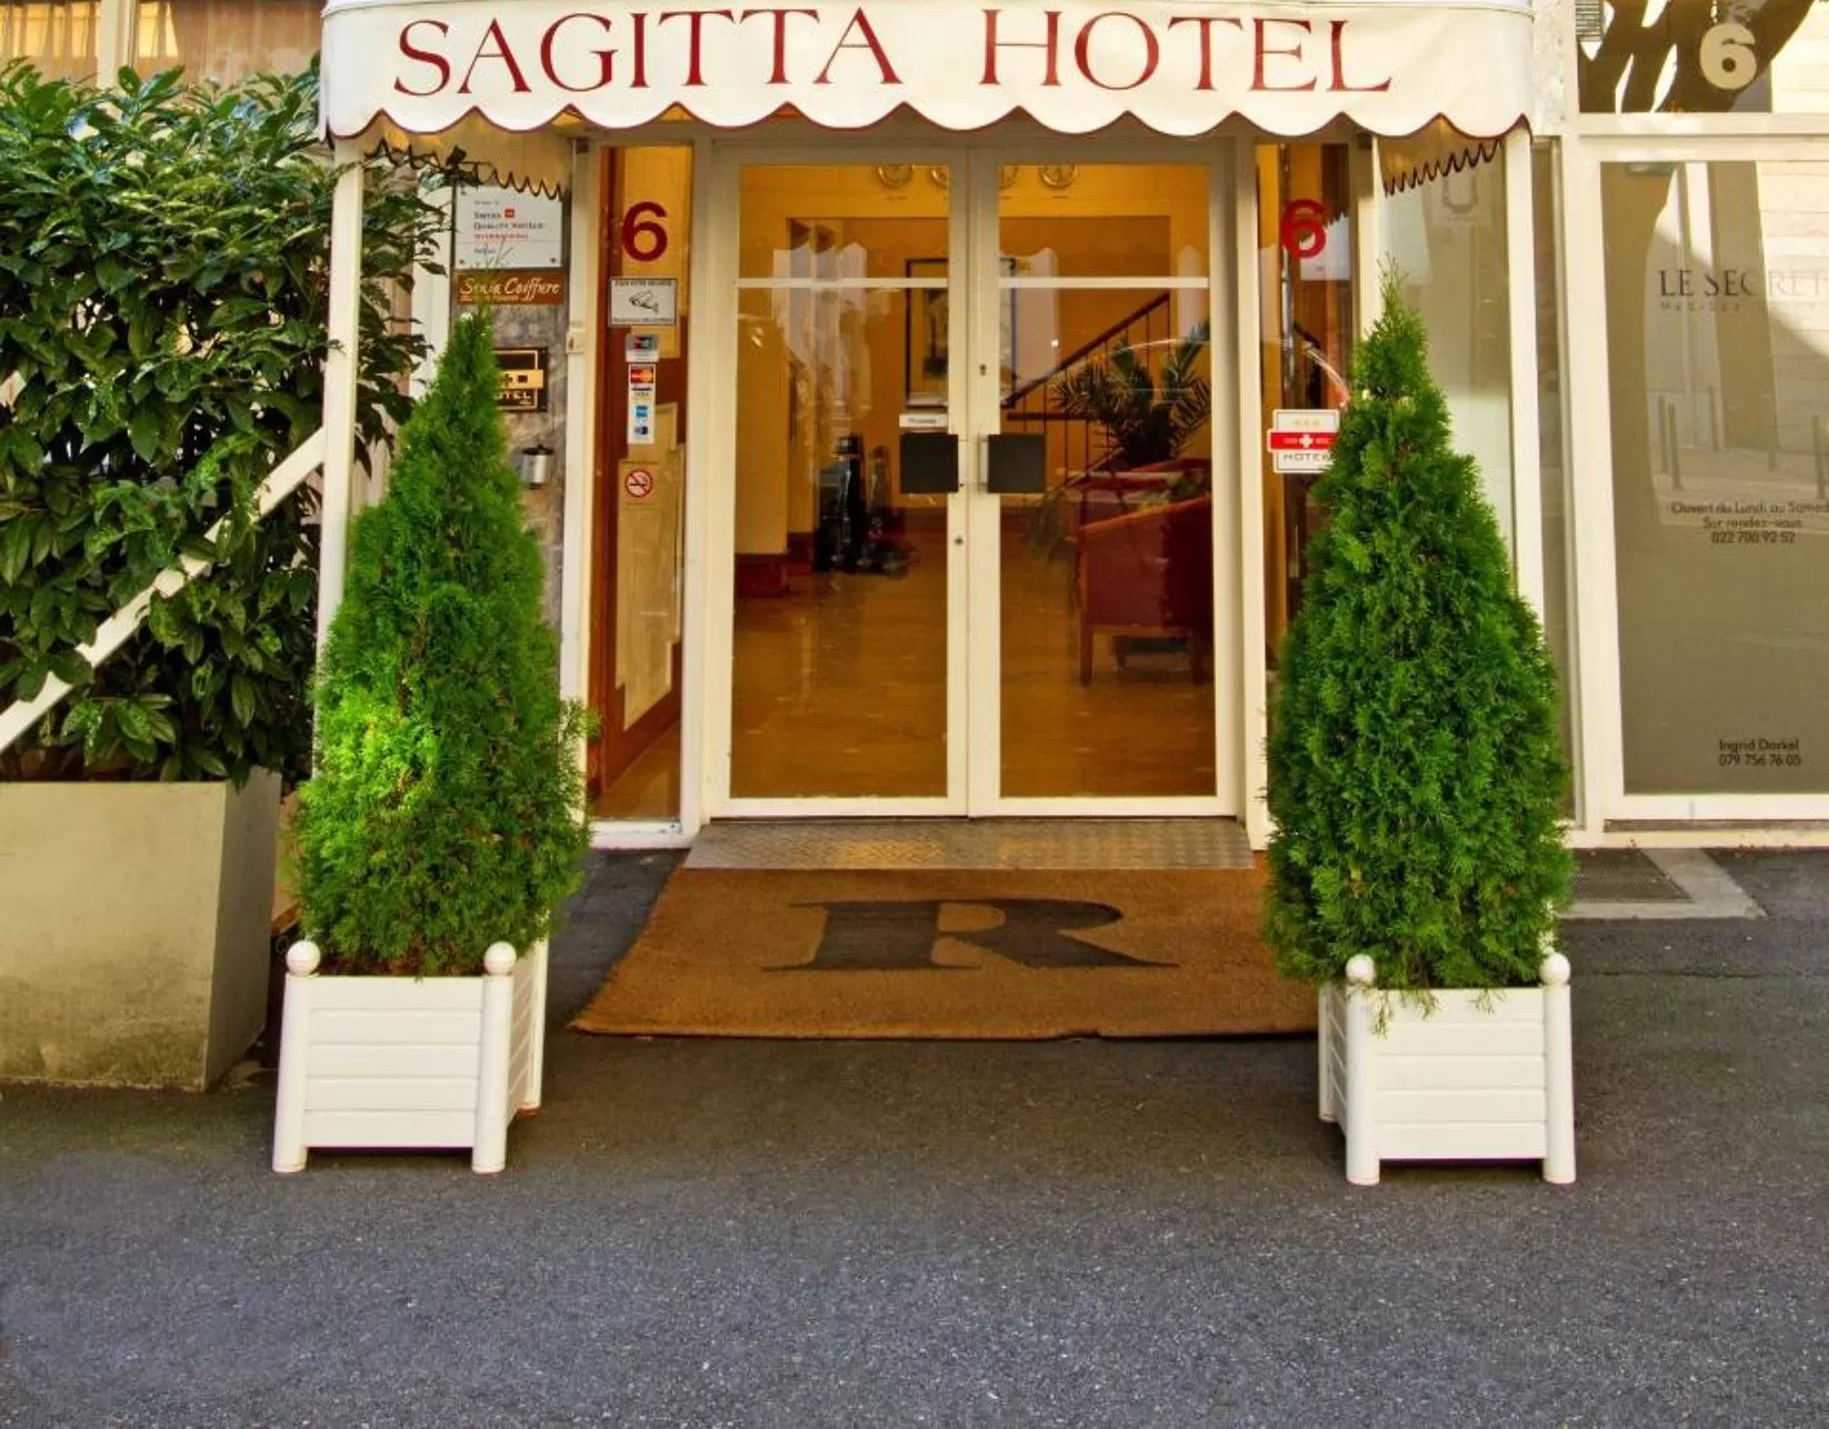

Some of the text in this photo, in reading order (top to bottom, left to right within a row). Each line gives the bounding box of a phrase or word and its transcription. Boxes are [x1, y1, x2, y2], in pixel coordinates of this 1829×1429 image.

[394, 8, 1394, 96] SAGITTA HOTEL
[1700, 22, 1757, 90] 6
[621, 201, 668, 262] 6
[1280, 198, 1326, 259] 6
[1659, 269, 1693, 297] LE
[763, 898, 1179, 971] R
